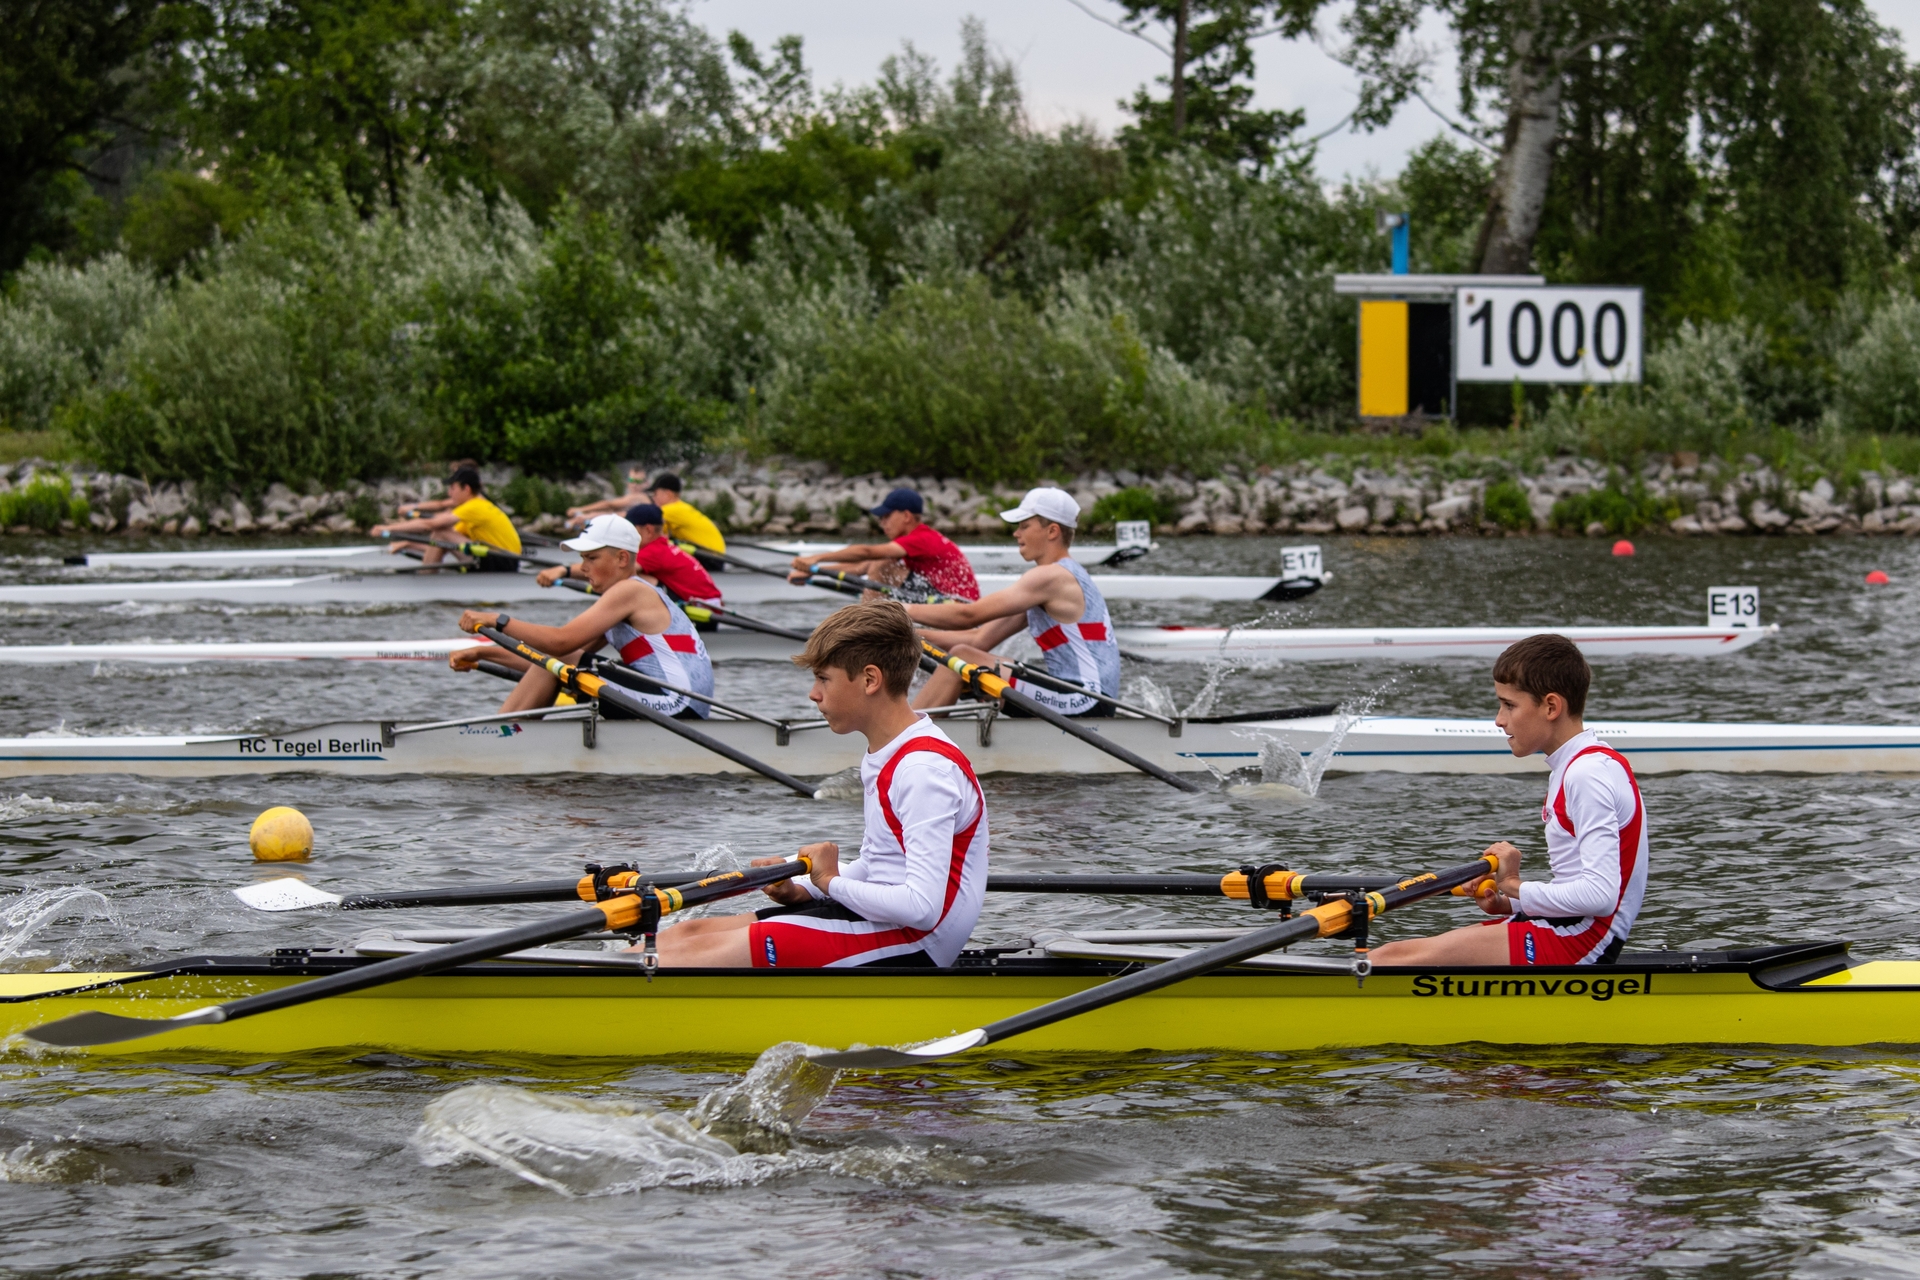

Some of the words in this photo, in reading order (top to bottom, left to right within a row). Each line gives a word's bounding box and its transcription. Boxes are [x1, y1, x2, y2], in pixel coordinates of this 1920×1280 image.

[1469, 299, 1627, 367] 1000
[1118, 526, 1147, 541] E15
[1282, 552, 1318, 570] E17
[1711, 593, 1757, 616] E13
[1035, 689, 1068, 709] Berliner
[239, 739, 267, 753] RC
[272, 739, 322, 756] Tegel
[329, 739, 382, 753] Berlin
[1412, 974, 1651, 1001] Sturmvogel
